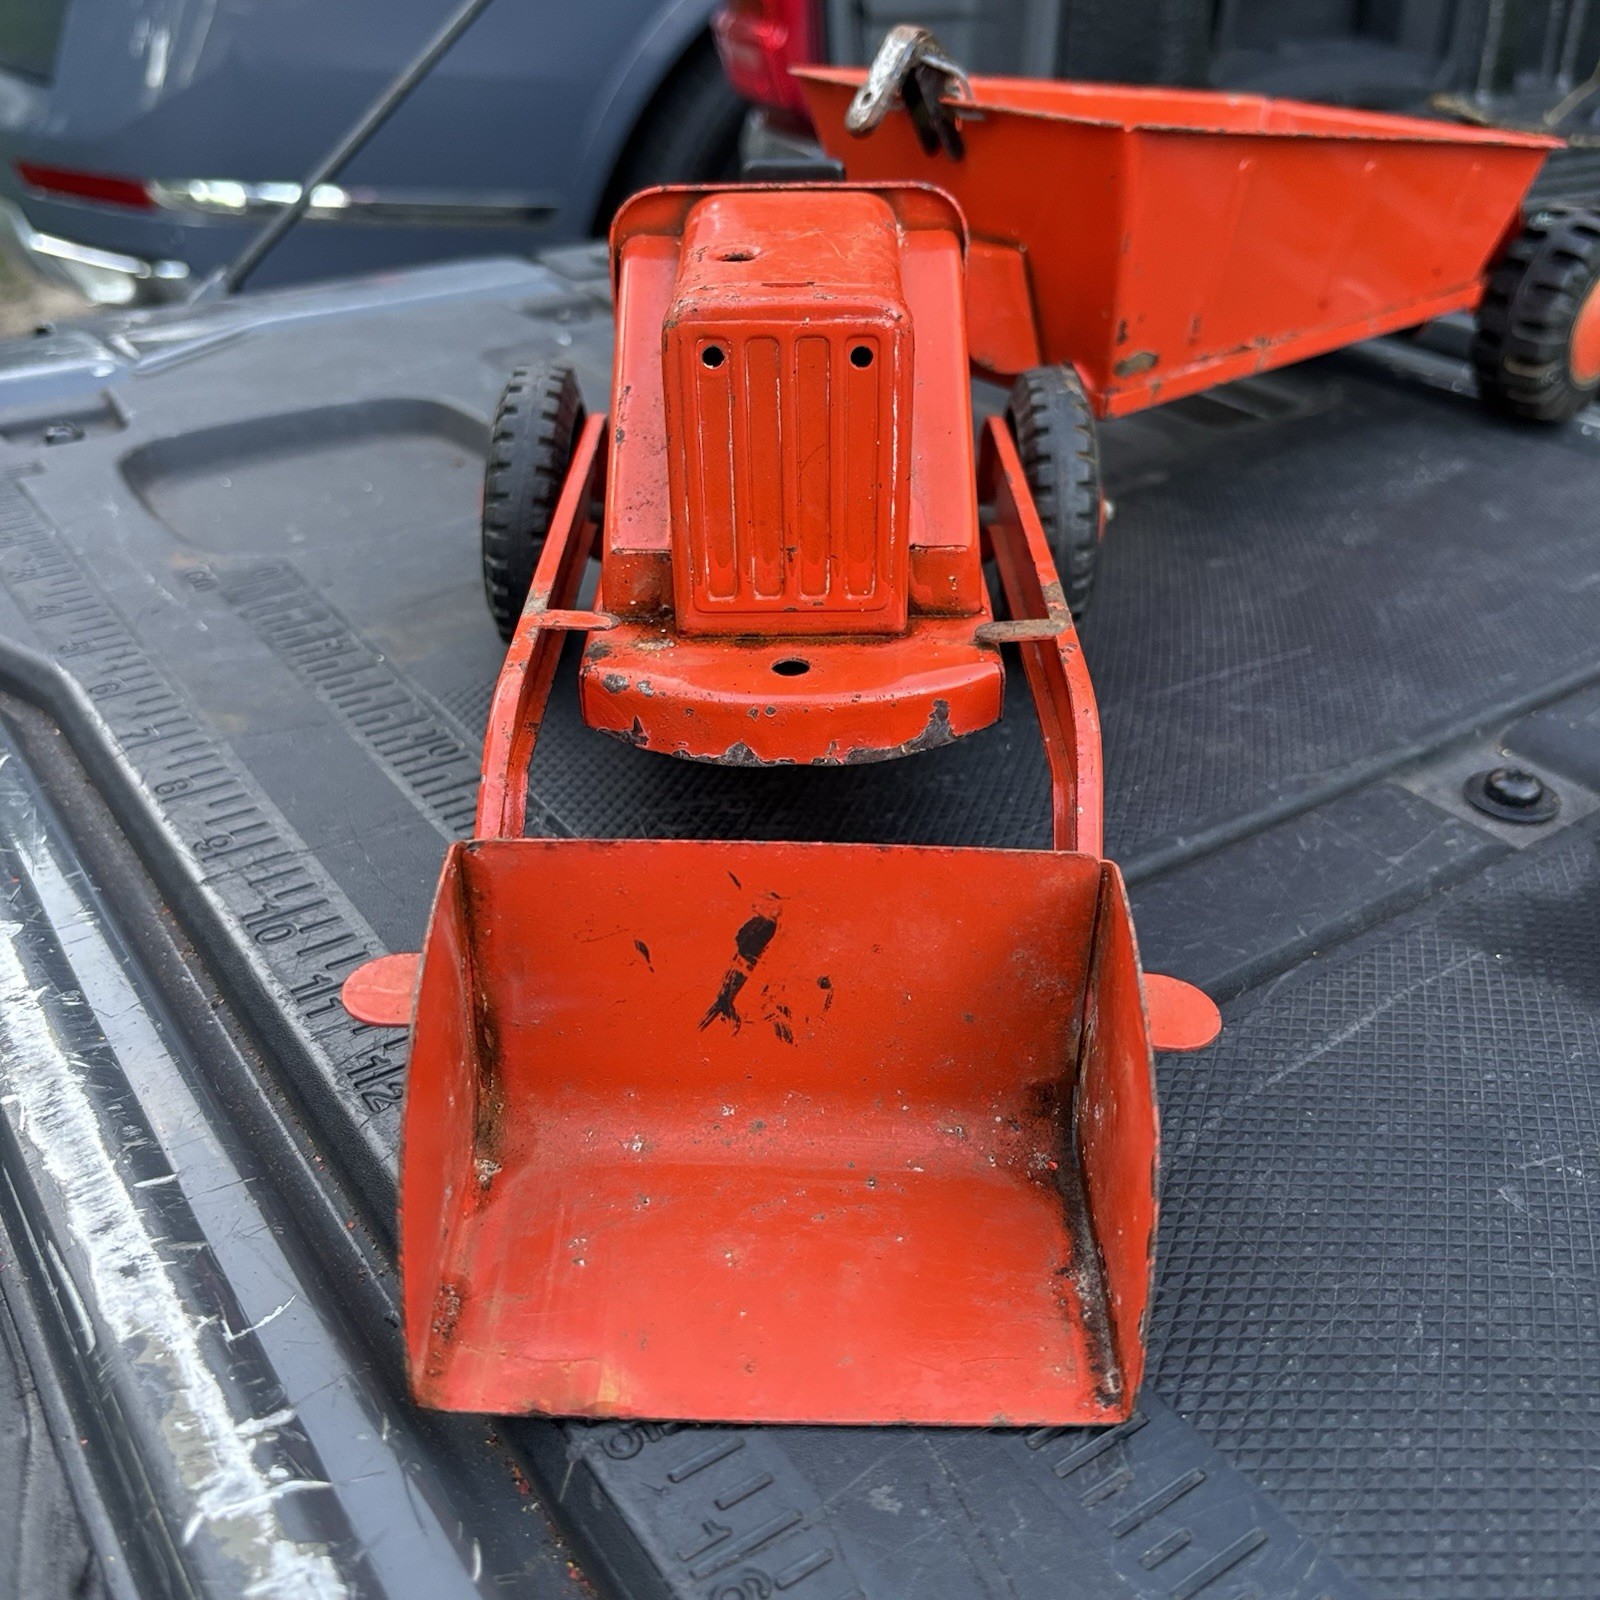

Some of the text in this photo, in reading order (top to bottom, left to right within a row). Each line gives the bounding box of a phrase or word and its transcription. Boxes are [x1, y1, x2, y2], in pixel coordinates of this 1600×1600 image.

[88, 677, 124, 695] 6
[118, 722, 158, 741] 7
[154, 777, 192, 796] 8
[193, 833, 235, 853] 9
[241, 901, 298, 945] 10
[347, 1055, 405, 1113] 12
